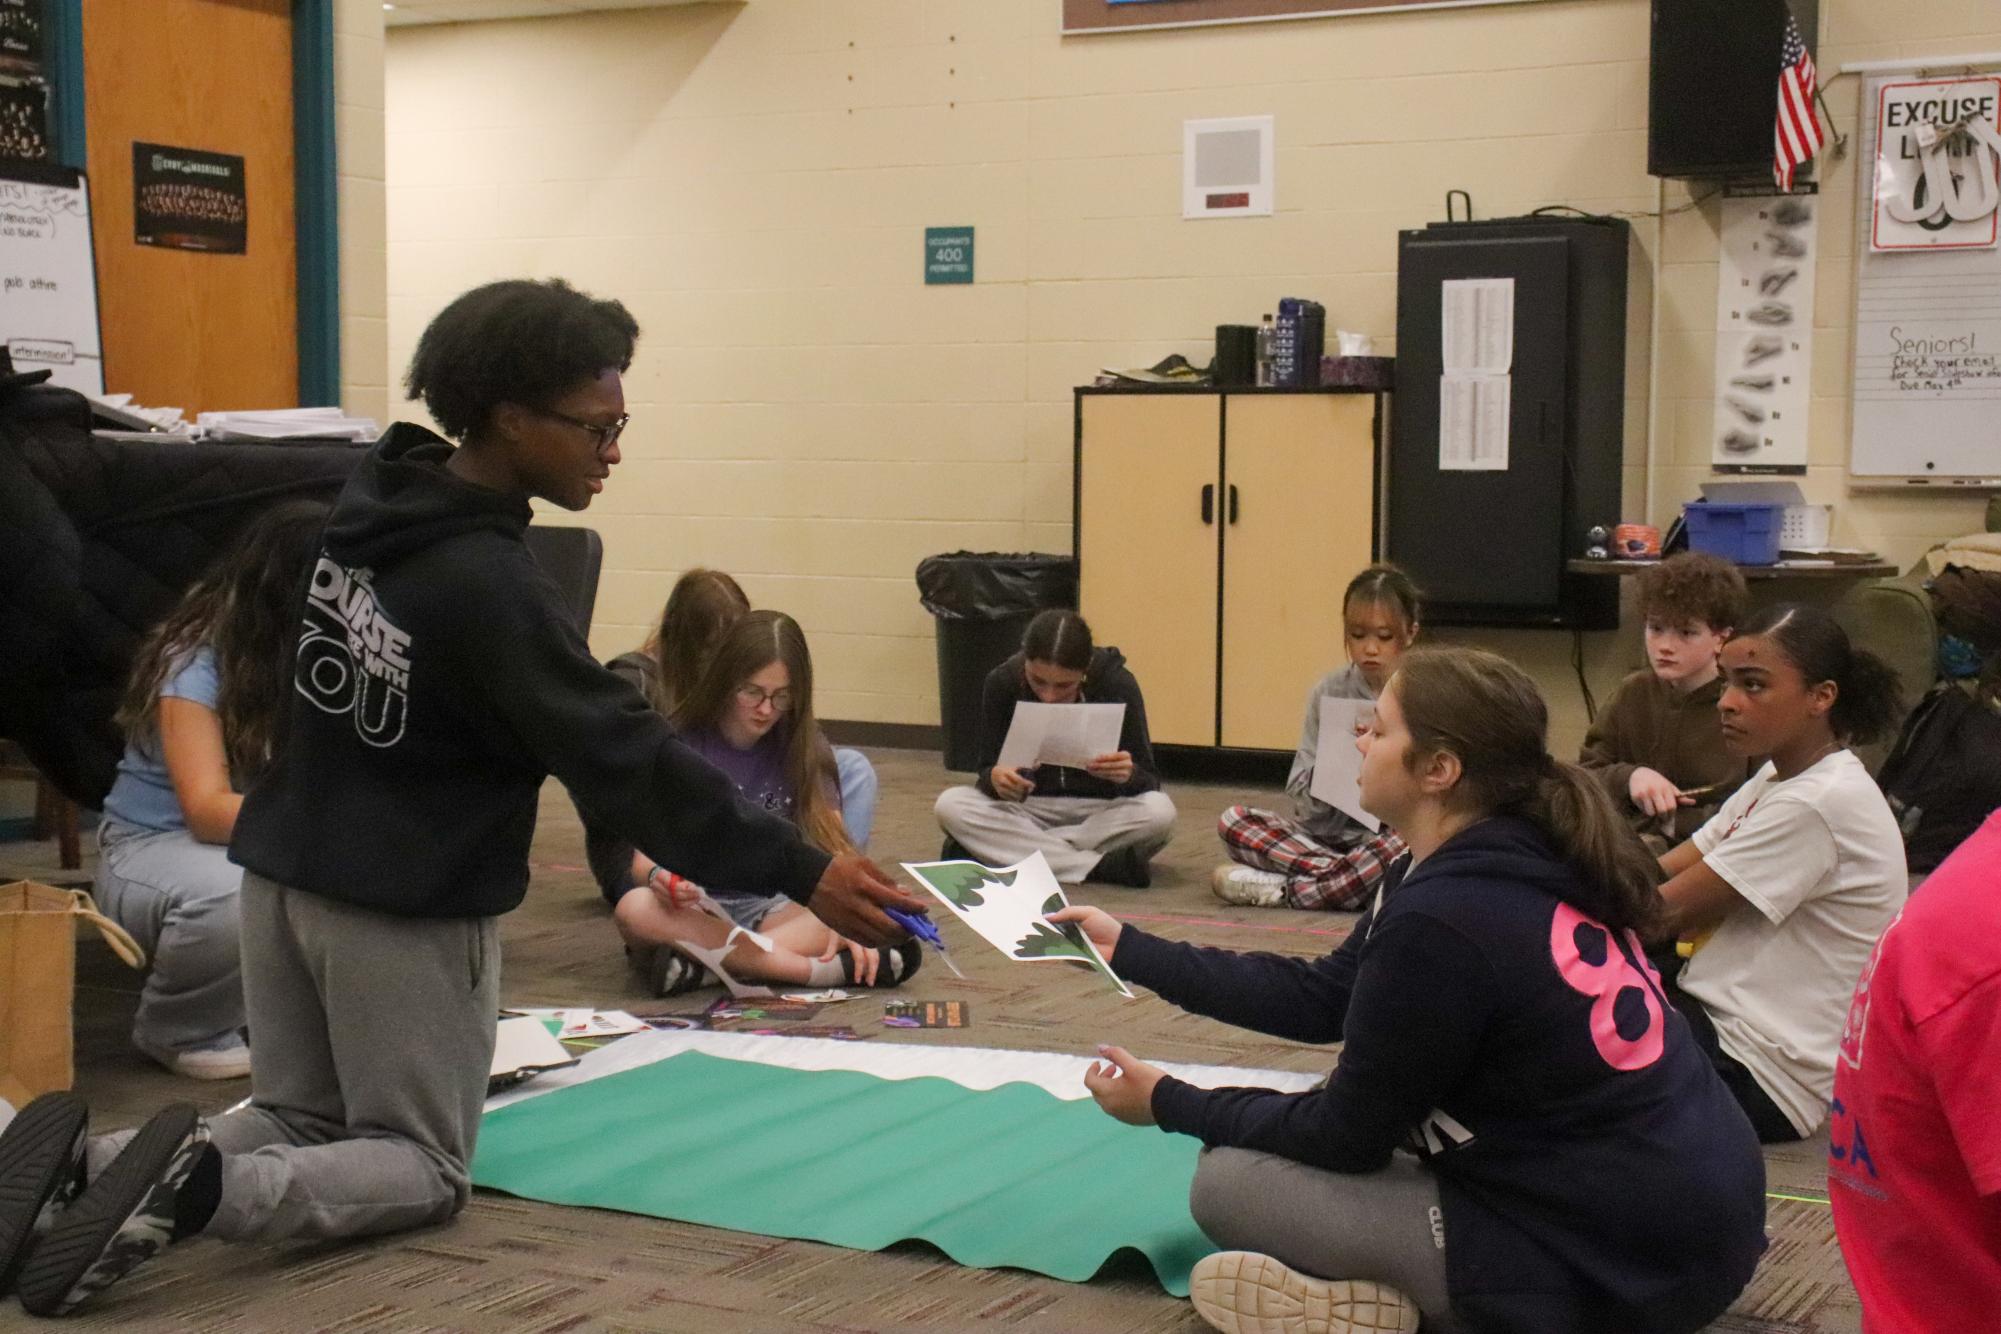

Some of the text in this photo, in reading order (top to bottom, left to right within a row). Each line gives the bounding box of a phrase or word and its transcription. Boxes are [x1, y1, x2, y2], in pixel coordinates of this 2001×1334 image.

[1887, 97, 1993, 128] EXCUSE
[935, 248, 963, 262] 400
[1890, 326, 1976, 356] Seniors!
[1934, 357, 1960, 372] your
